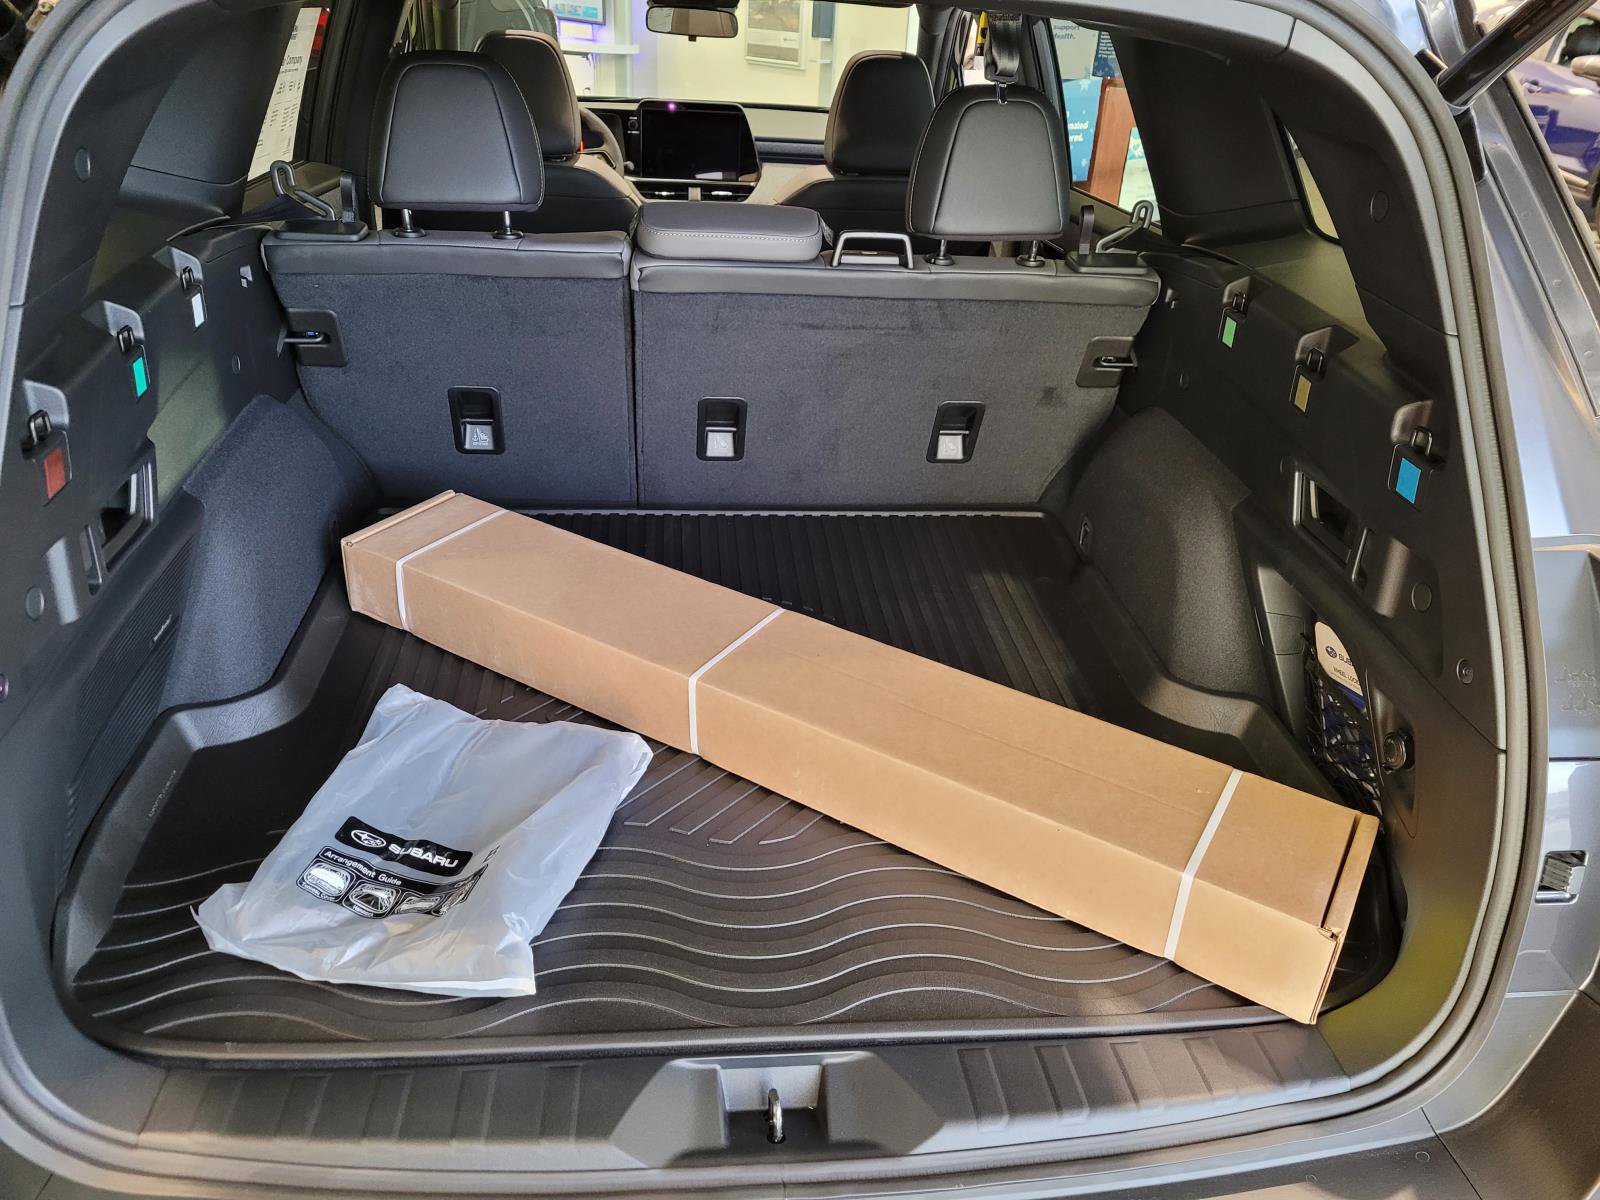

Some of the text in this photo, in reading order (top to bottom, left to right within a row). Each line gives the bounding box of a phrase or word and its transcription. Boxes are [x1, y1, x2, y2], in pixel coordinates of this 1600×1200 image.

[1338, 653, 1353, 666] SUB
[324, 850, 402, 886] Arrangement Guide
[388, 843, 458, 868] SUBARU
